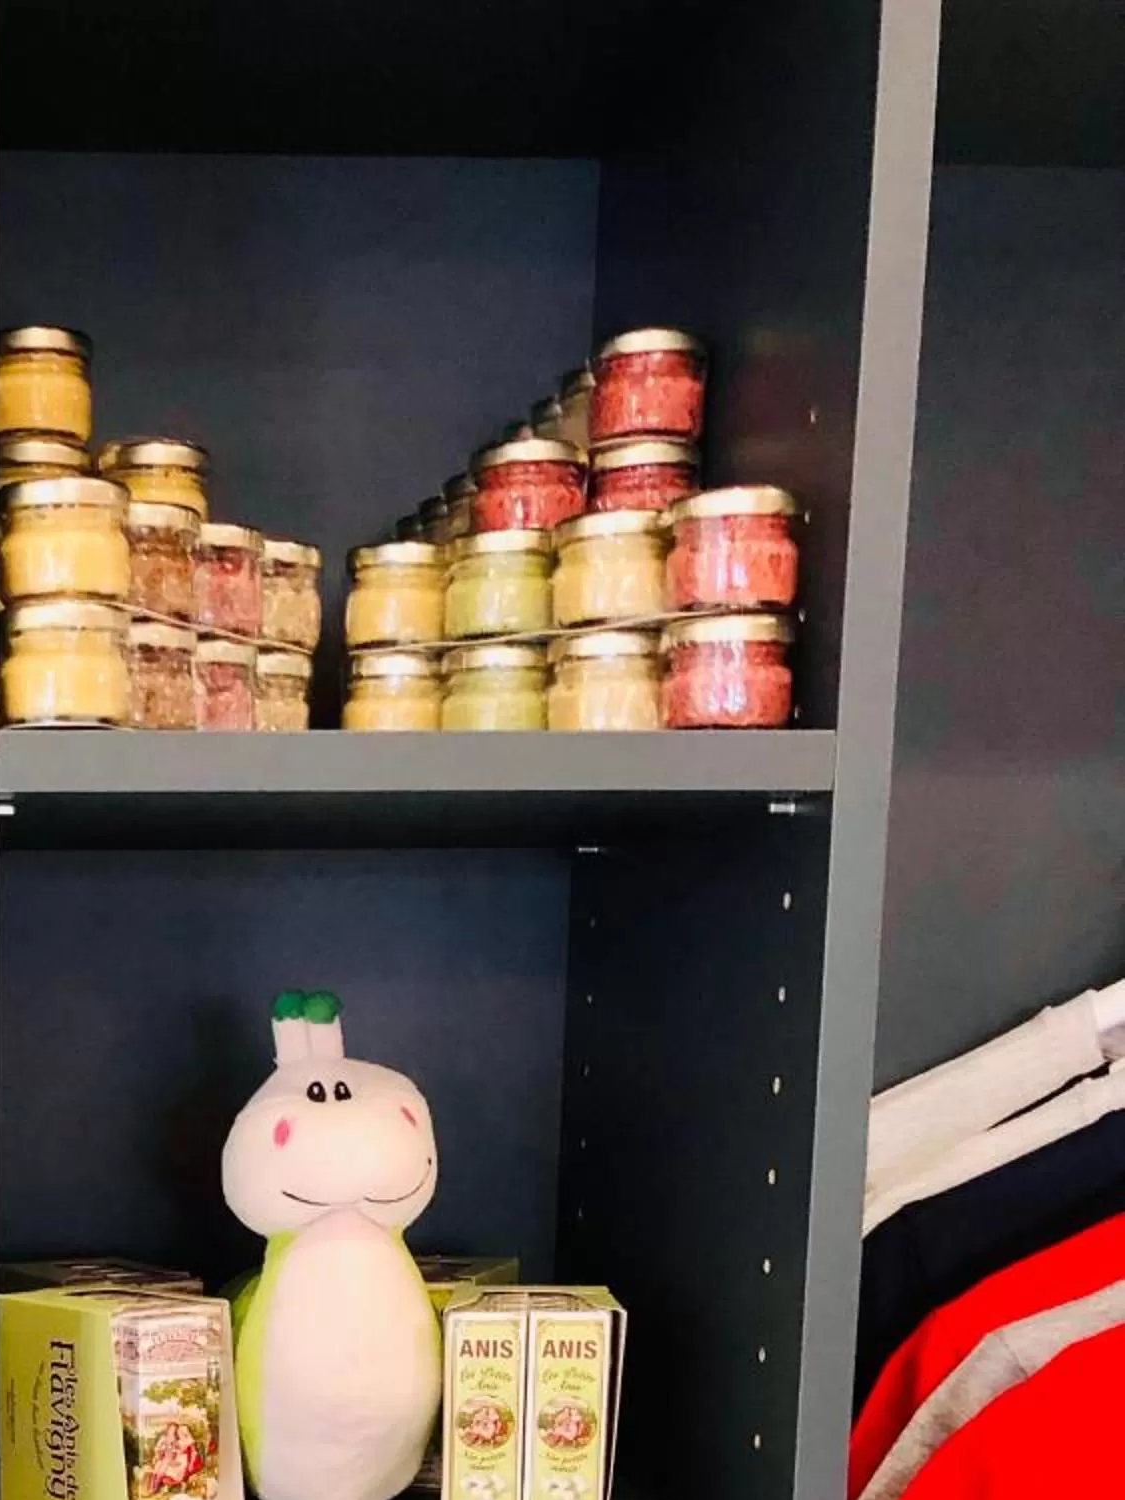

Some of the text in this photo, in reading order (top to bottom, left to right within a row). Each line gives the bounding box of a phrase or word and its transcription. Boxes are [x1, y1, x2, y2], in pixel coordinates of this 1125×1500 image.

[459, 1339, 514, 1359] ANIS
[542, 1339, 598, 1359] ANIS
[44, 1340, 75, 1500] Flavigny
